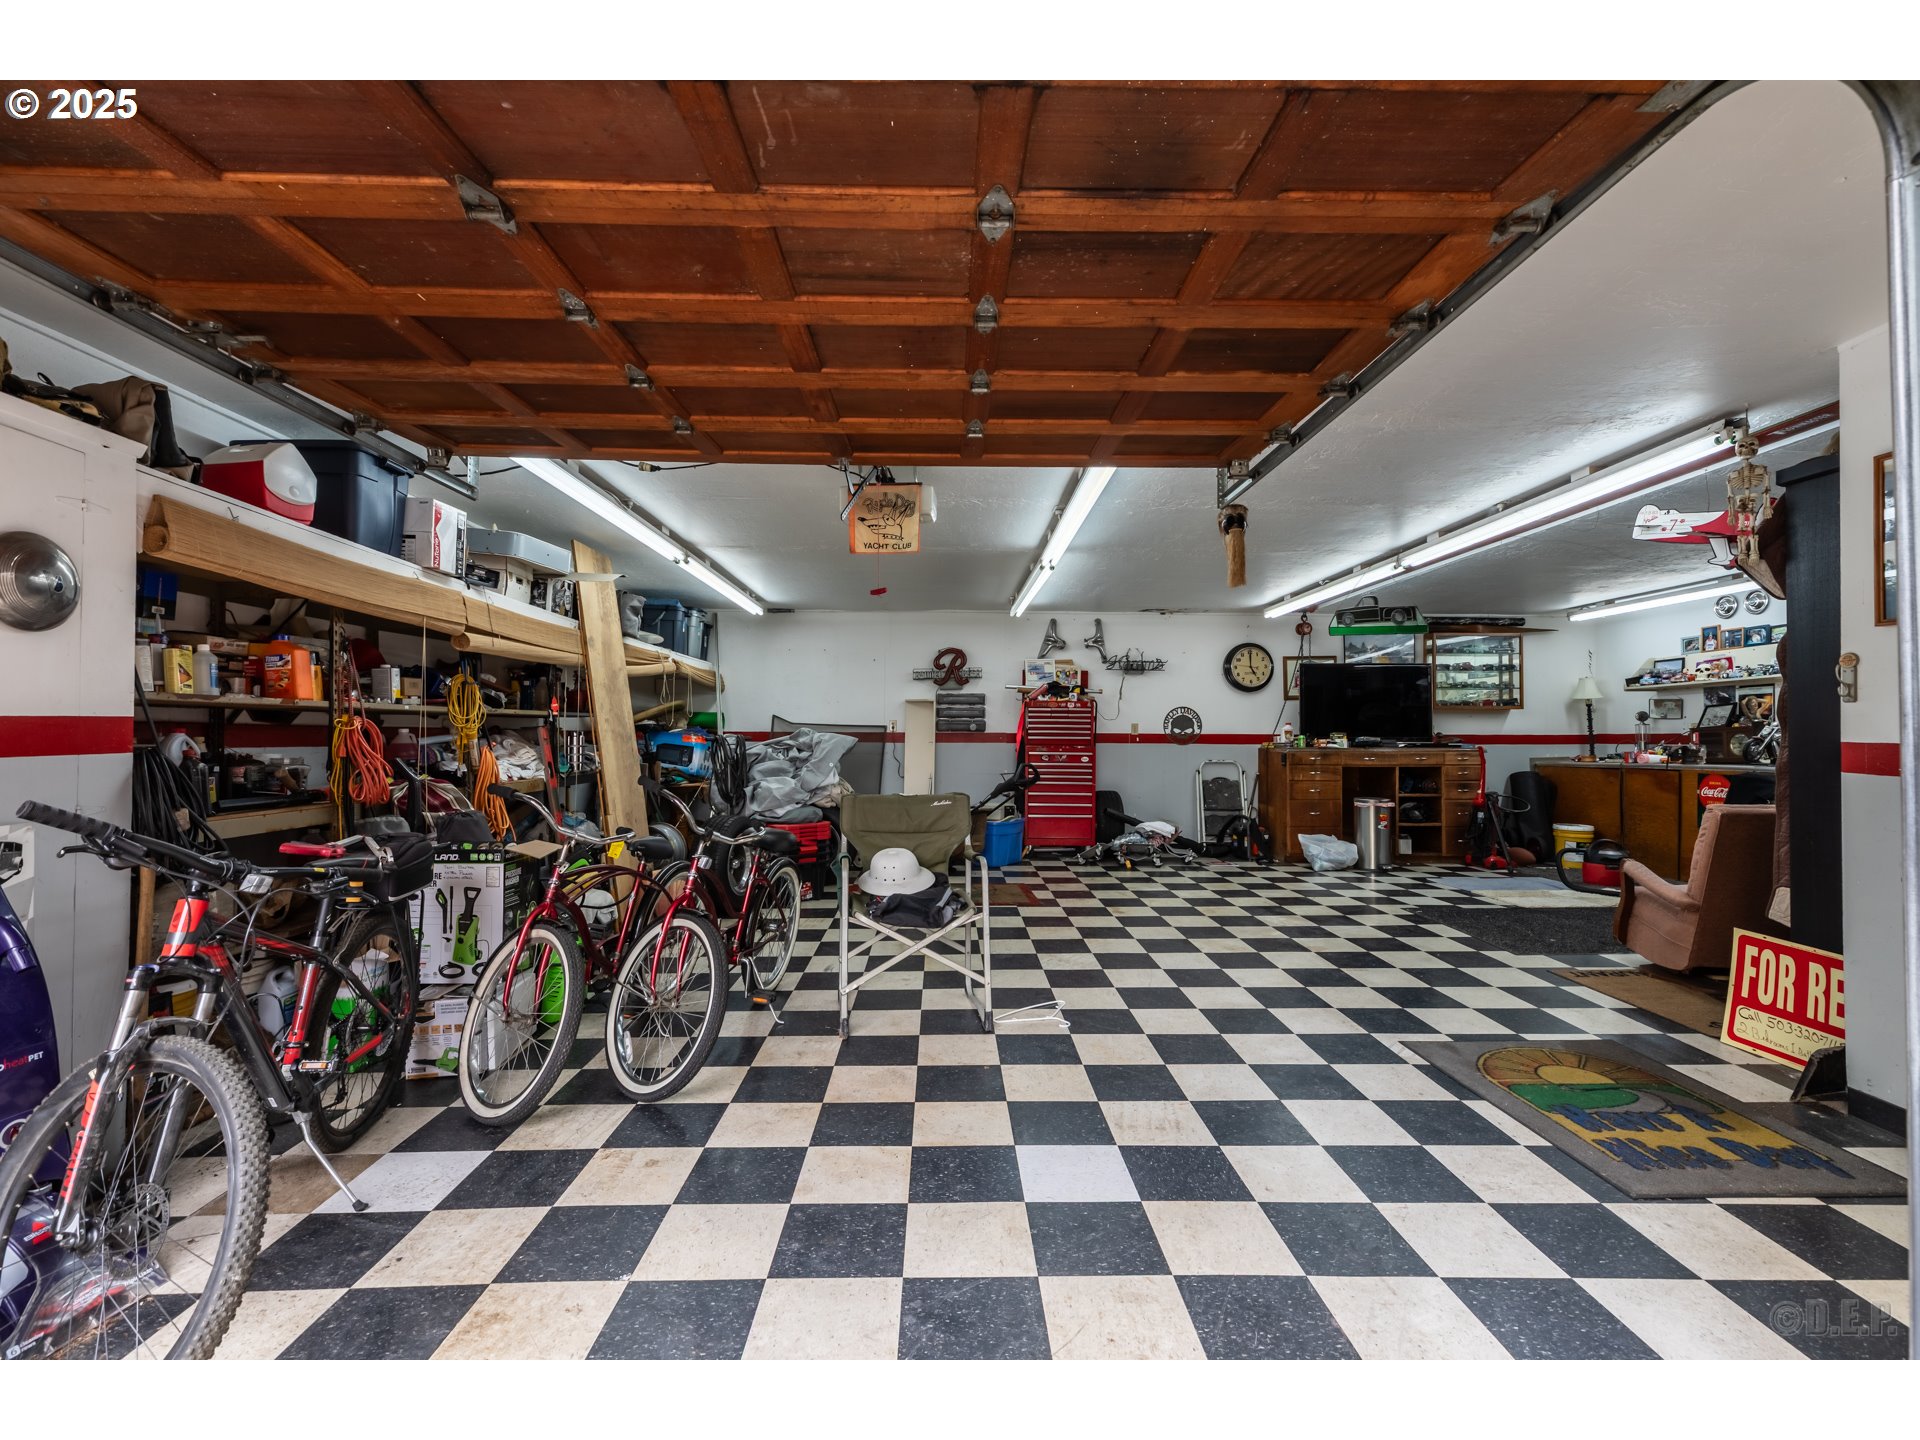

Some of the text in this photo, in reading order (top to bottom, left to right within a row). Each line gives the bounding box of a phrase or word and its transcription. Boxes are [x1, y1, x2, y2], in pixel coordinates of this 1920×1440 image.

[1670, 519, 1678, 531] 7
[863, 542, 912, 550] YACHT CLUB
[1741, 944, 1845, 1030] FOR RE
[1738, 1007, 1762, 1024] Call
[1736, 1022, 1749, 1036] 2
[1549, 1103, 1686, 1133] Have
[1591, 1136, 1856, 1179] Nice Day
